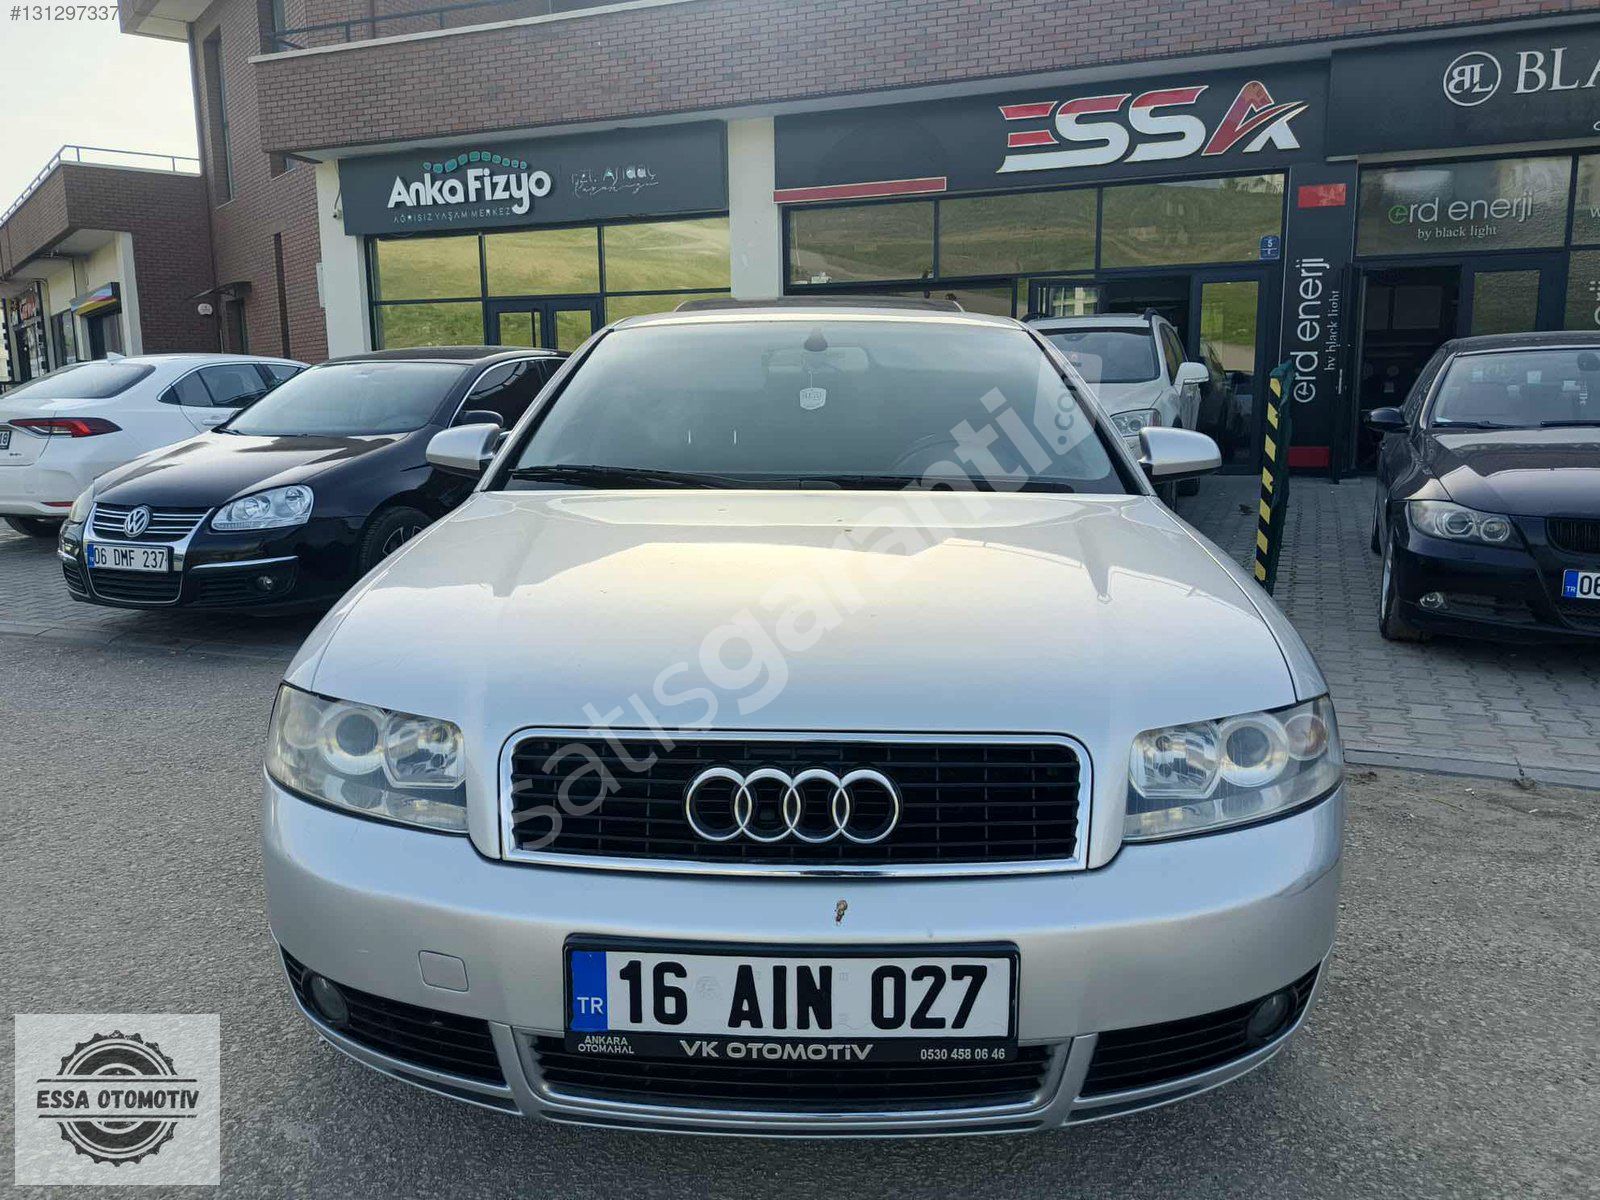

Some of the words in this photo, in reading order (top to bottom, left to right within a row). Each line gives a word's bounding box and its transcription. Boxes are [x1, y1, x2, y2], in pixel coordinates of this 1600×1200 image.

[996, 80, 1309, 174] ESSA
[1388, 197, 1439, 224] erd
[1448, 191, 1533, 222] enerji
[1417, 228, 1432, 241] by
[1435, 225, 1466, 238] black
[1470, 225, 1498, 239] light
[1295, 258, 1330, 341] enerji
[1289, 351, 1318, 403] erd
[94, 547, 107, 565] 06
[114, 548, 135, 567] DMF
[142, 550, 165, 569] 237
[619, 960, 688, 1026] 16
[727, 964, 833, 1030] AIN
[870, 964, 988, 1030] 027
[576, 996, 604, 1015] TR
[577, 1043, 635, 1054] OTOMAHAL
[584, 1035, 628, 1046] ANKARA
[679, 1039, 720, 1058] VK
[920, 1047, 948, 1060] 0530
[950, 1047, 972, 1060] 458
[974, 1047, 989, 1060] 06
[991, 1047, 1006, 1060] 46
